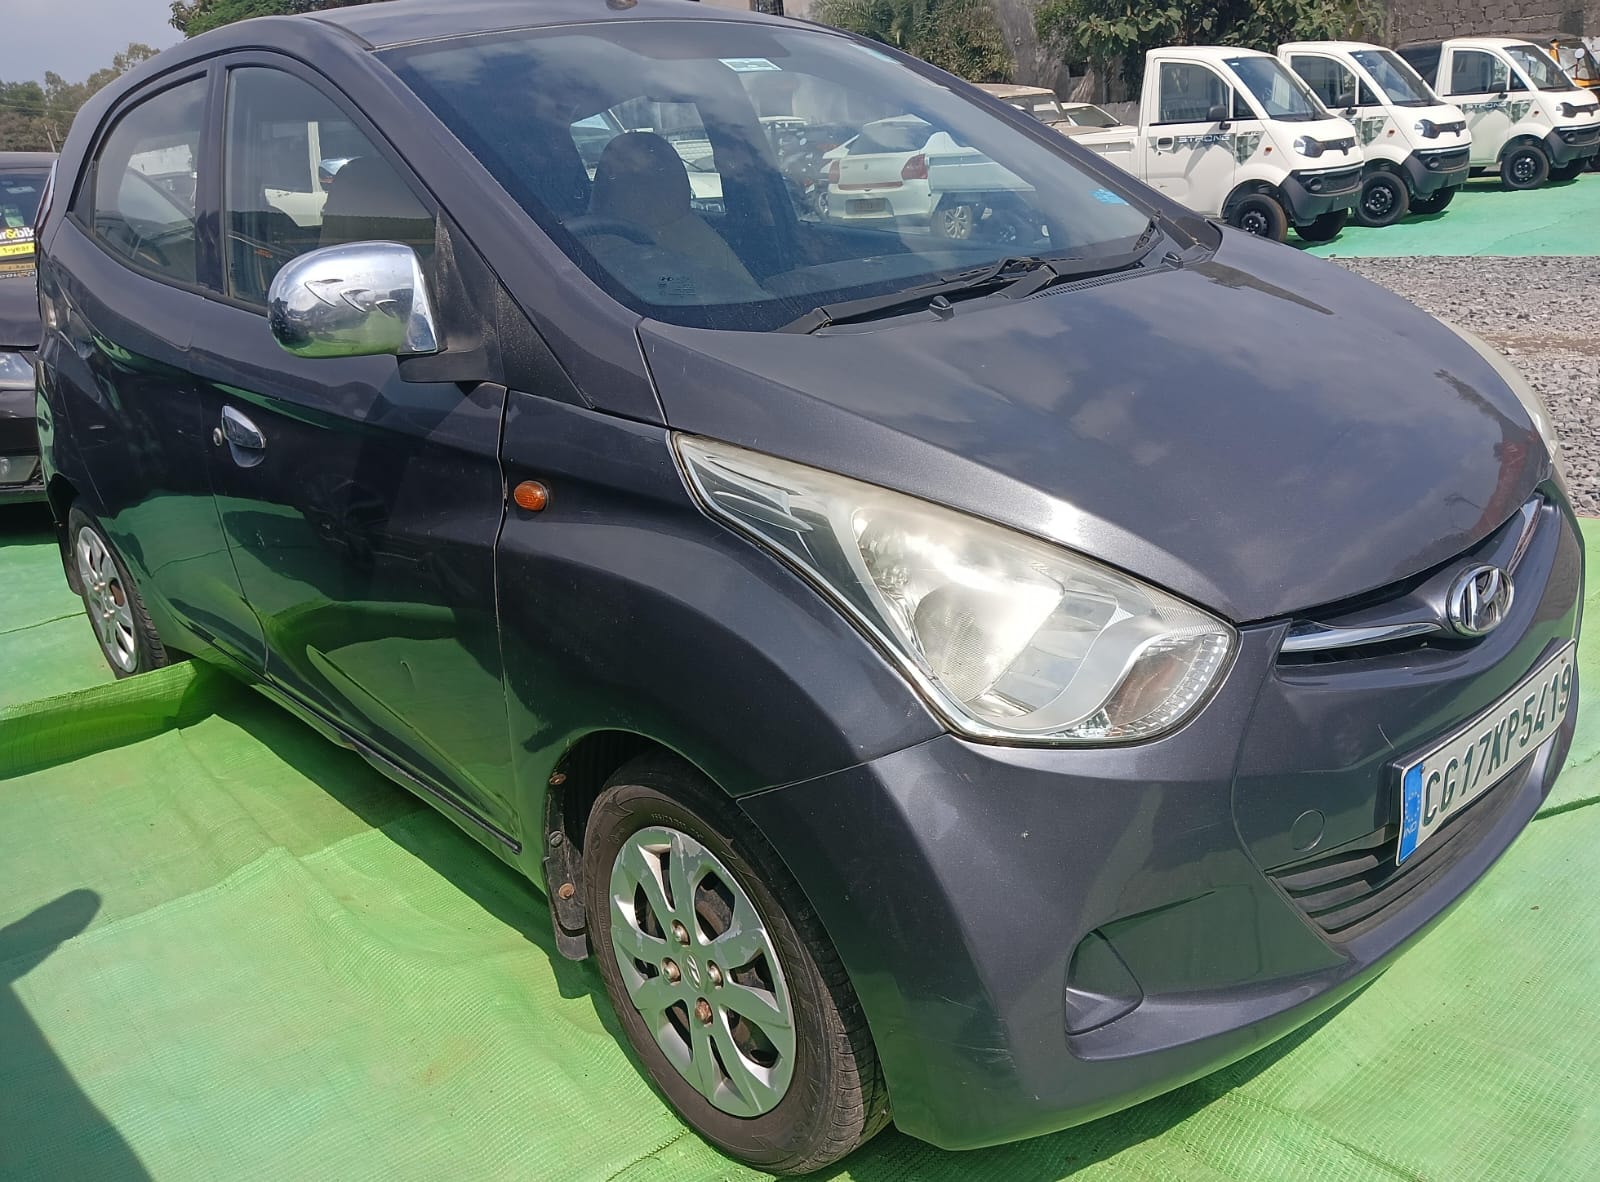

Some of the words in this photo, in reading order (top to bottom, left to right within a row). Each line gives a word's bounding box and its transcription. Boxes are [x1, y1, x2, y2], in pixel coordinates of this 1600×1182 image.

[1177, 134, 1231, 143] STRONG
[1421, 662, 1572, 827] CG17KP5419
[1403, 820, 1417, 838] IND
